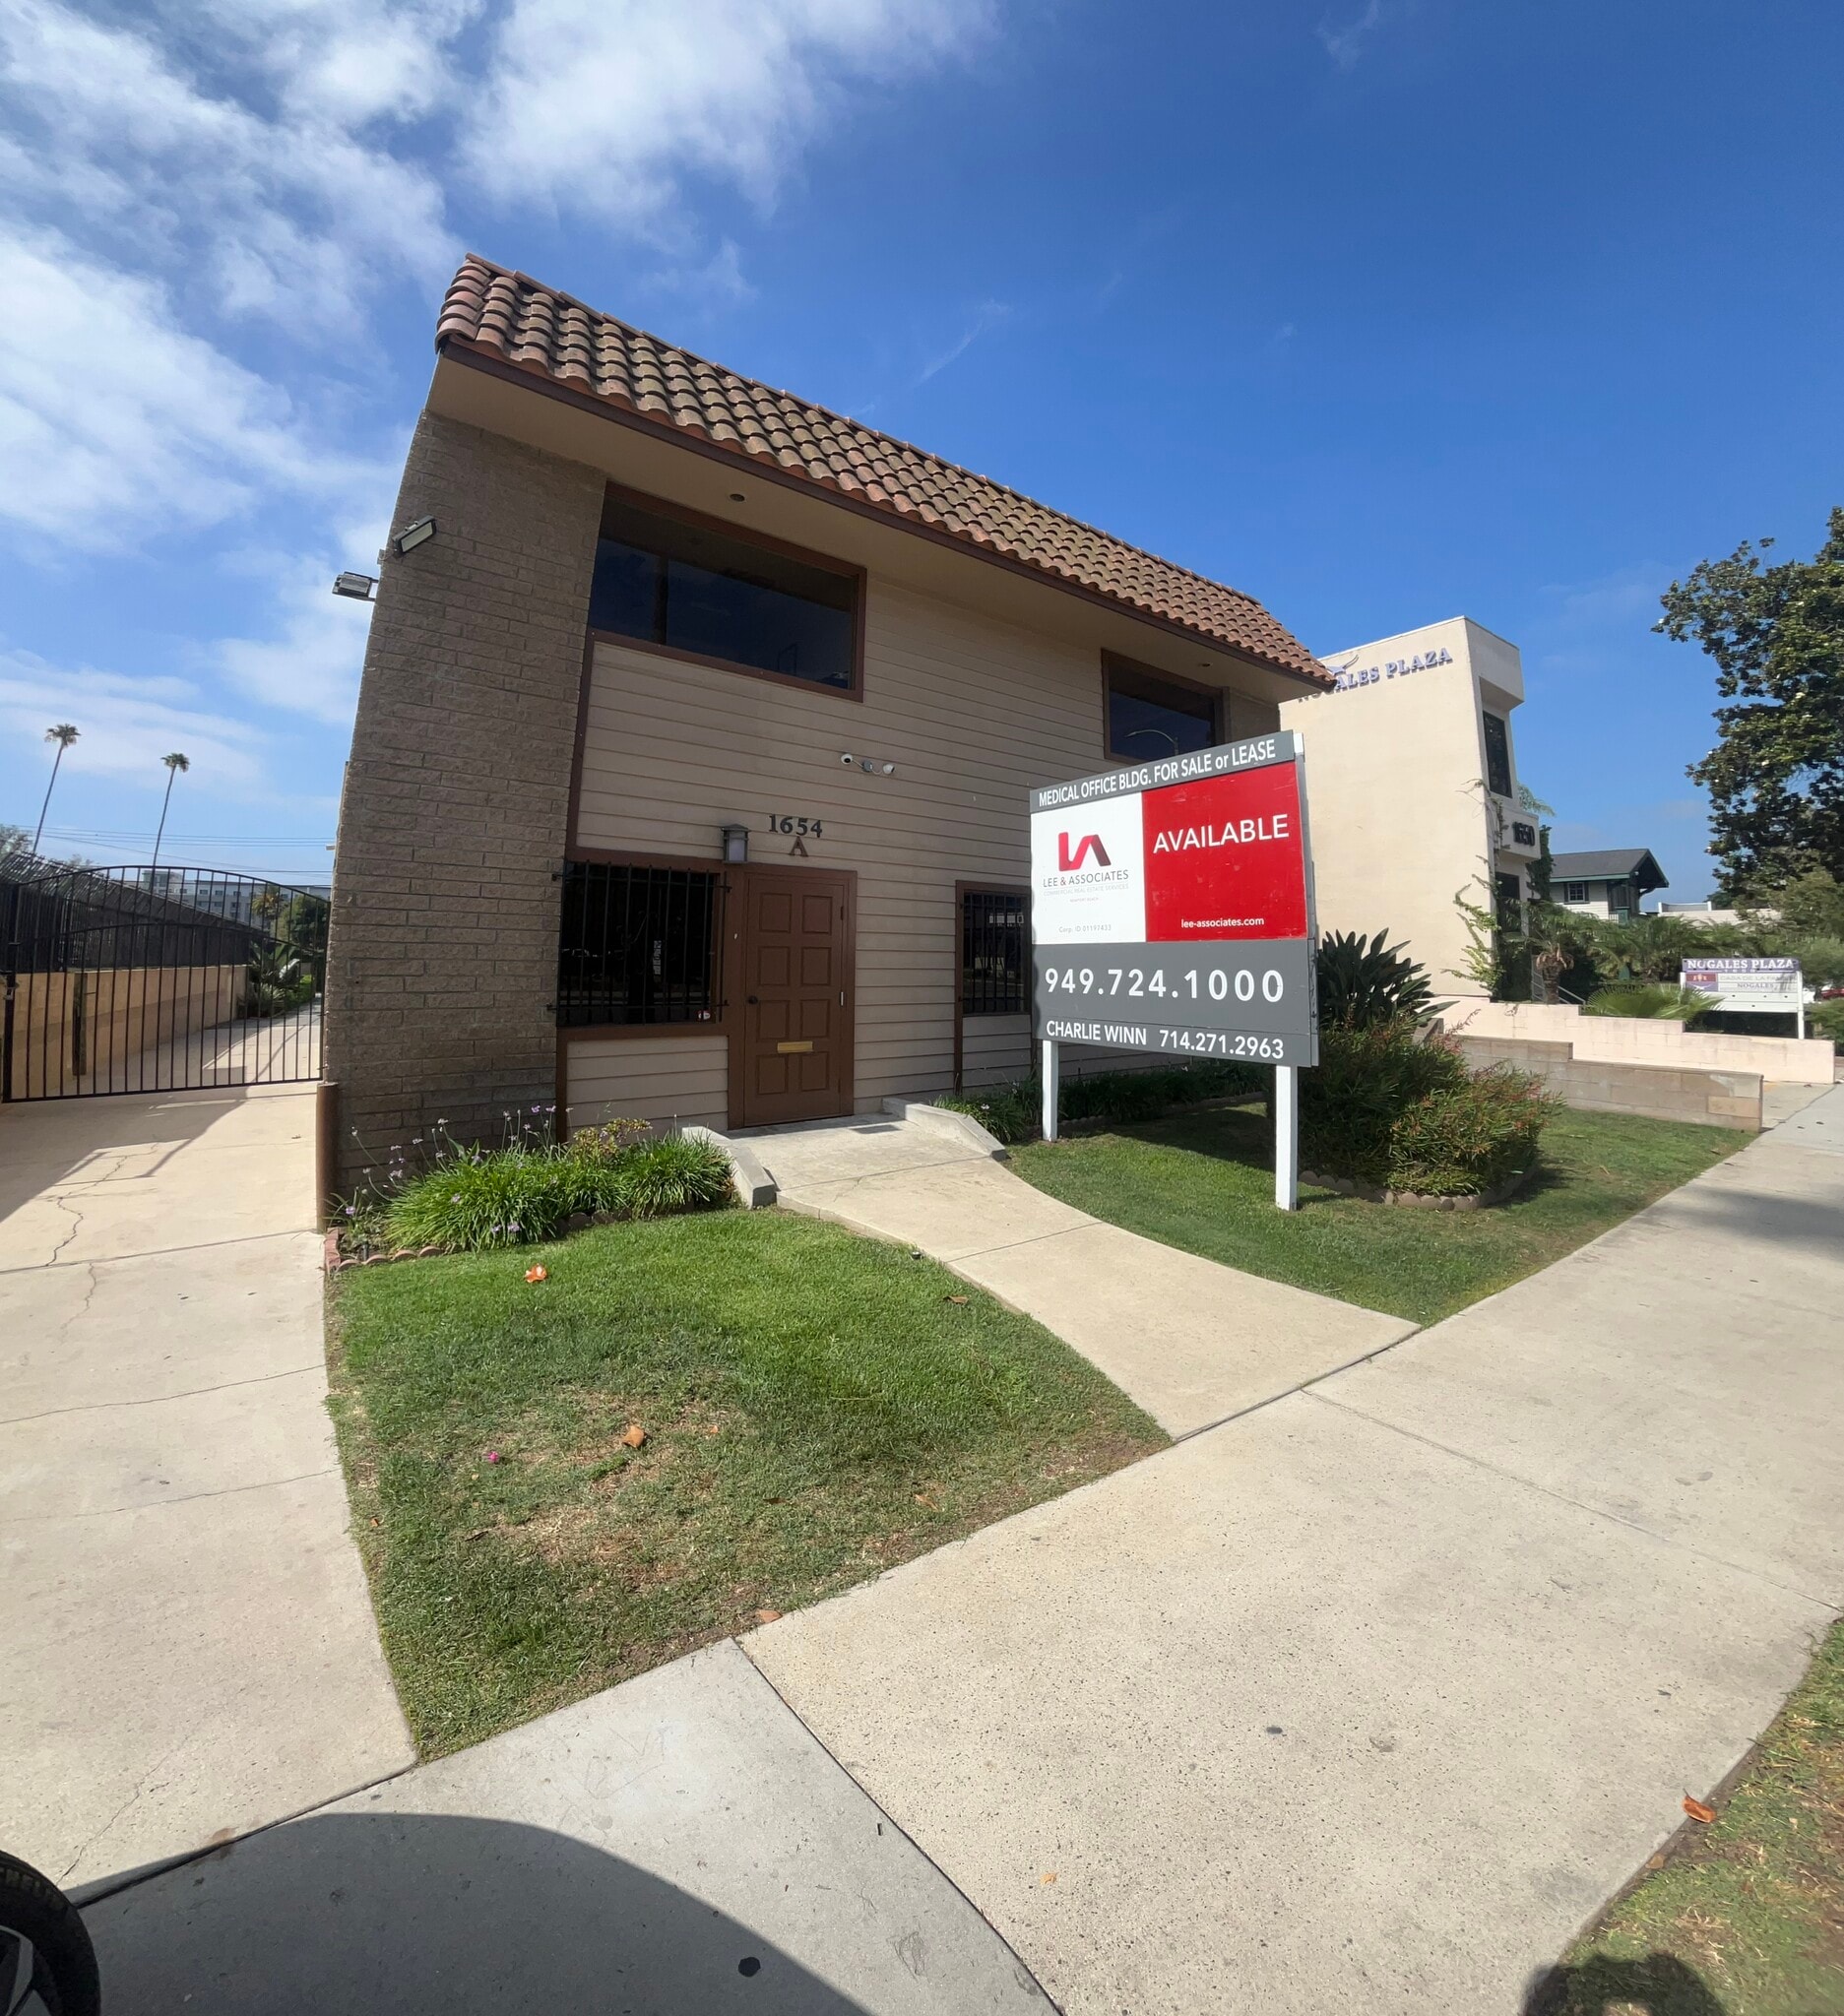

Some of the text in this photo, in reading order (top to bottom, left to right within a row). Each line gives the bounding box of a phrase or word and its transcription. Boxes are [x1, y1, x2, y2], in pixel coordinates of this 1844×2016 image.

[1385, 647, 1453, 679] PLAZA
[1039, 738, 1276, 807] MEDICAL OFFICE BLDG. FOR SALE or LEASE
[769, 813, 823, 838] 1654
[1153, 814, 1290, 853] AVAILABLE
[790, 836, 808, 857] A
[1043, 869, 1129, 888] LEE & ASSOCIATES
[1180, 916, 1265, 929] lee-associates.com
[1687, 959, 1794, 970] NOGALES PLAZA
[1045, 968, 1284, 1003] 949.724.1000
[1046, 1020, 1284, 1059] CHARLIE WINN 714.271.2963
